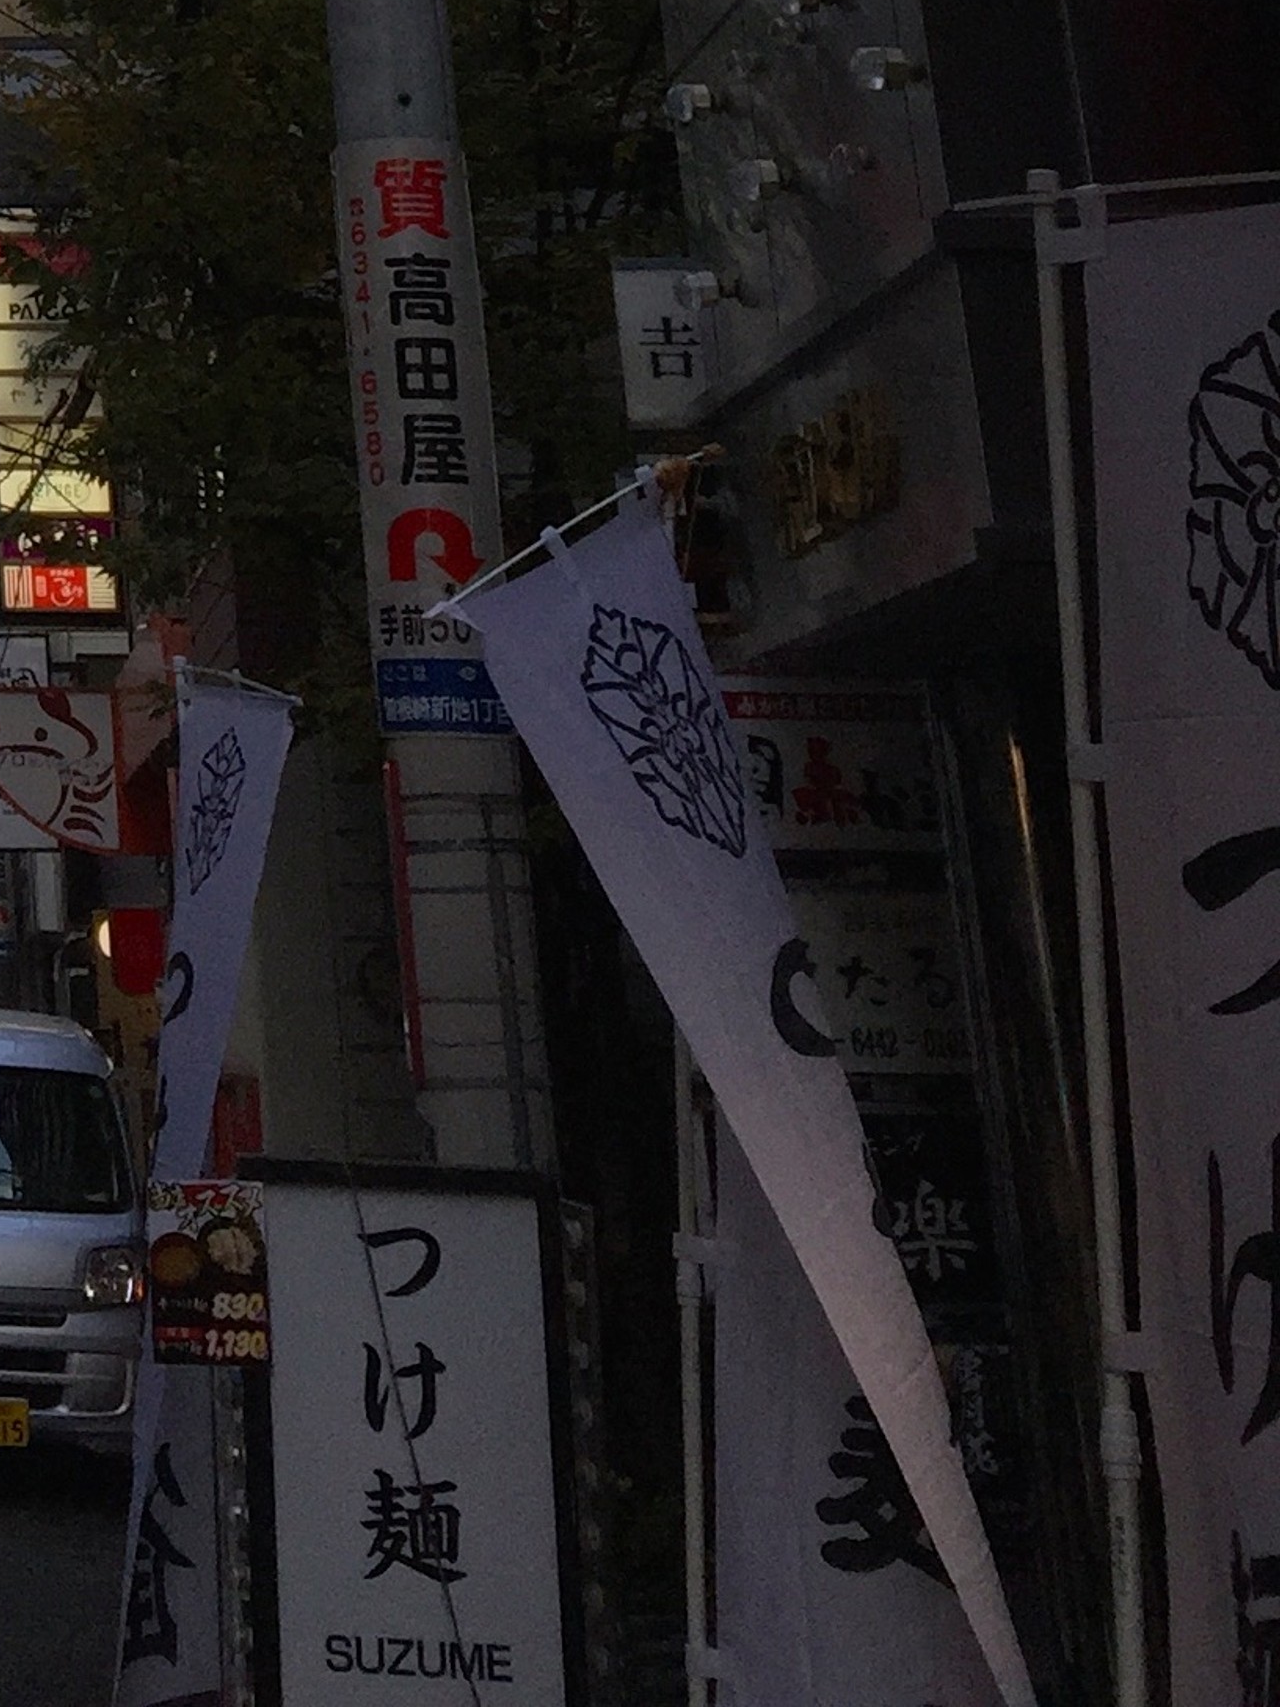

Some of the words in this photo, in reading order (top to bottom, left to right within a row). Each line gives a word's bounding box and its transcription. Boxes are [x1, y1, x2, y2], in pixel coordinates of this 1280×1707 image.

[358, 1227, 468, 1584] つけ麺
[325, 1633, 515, 1684] SUZUME
